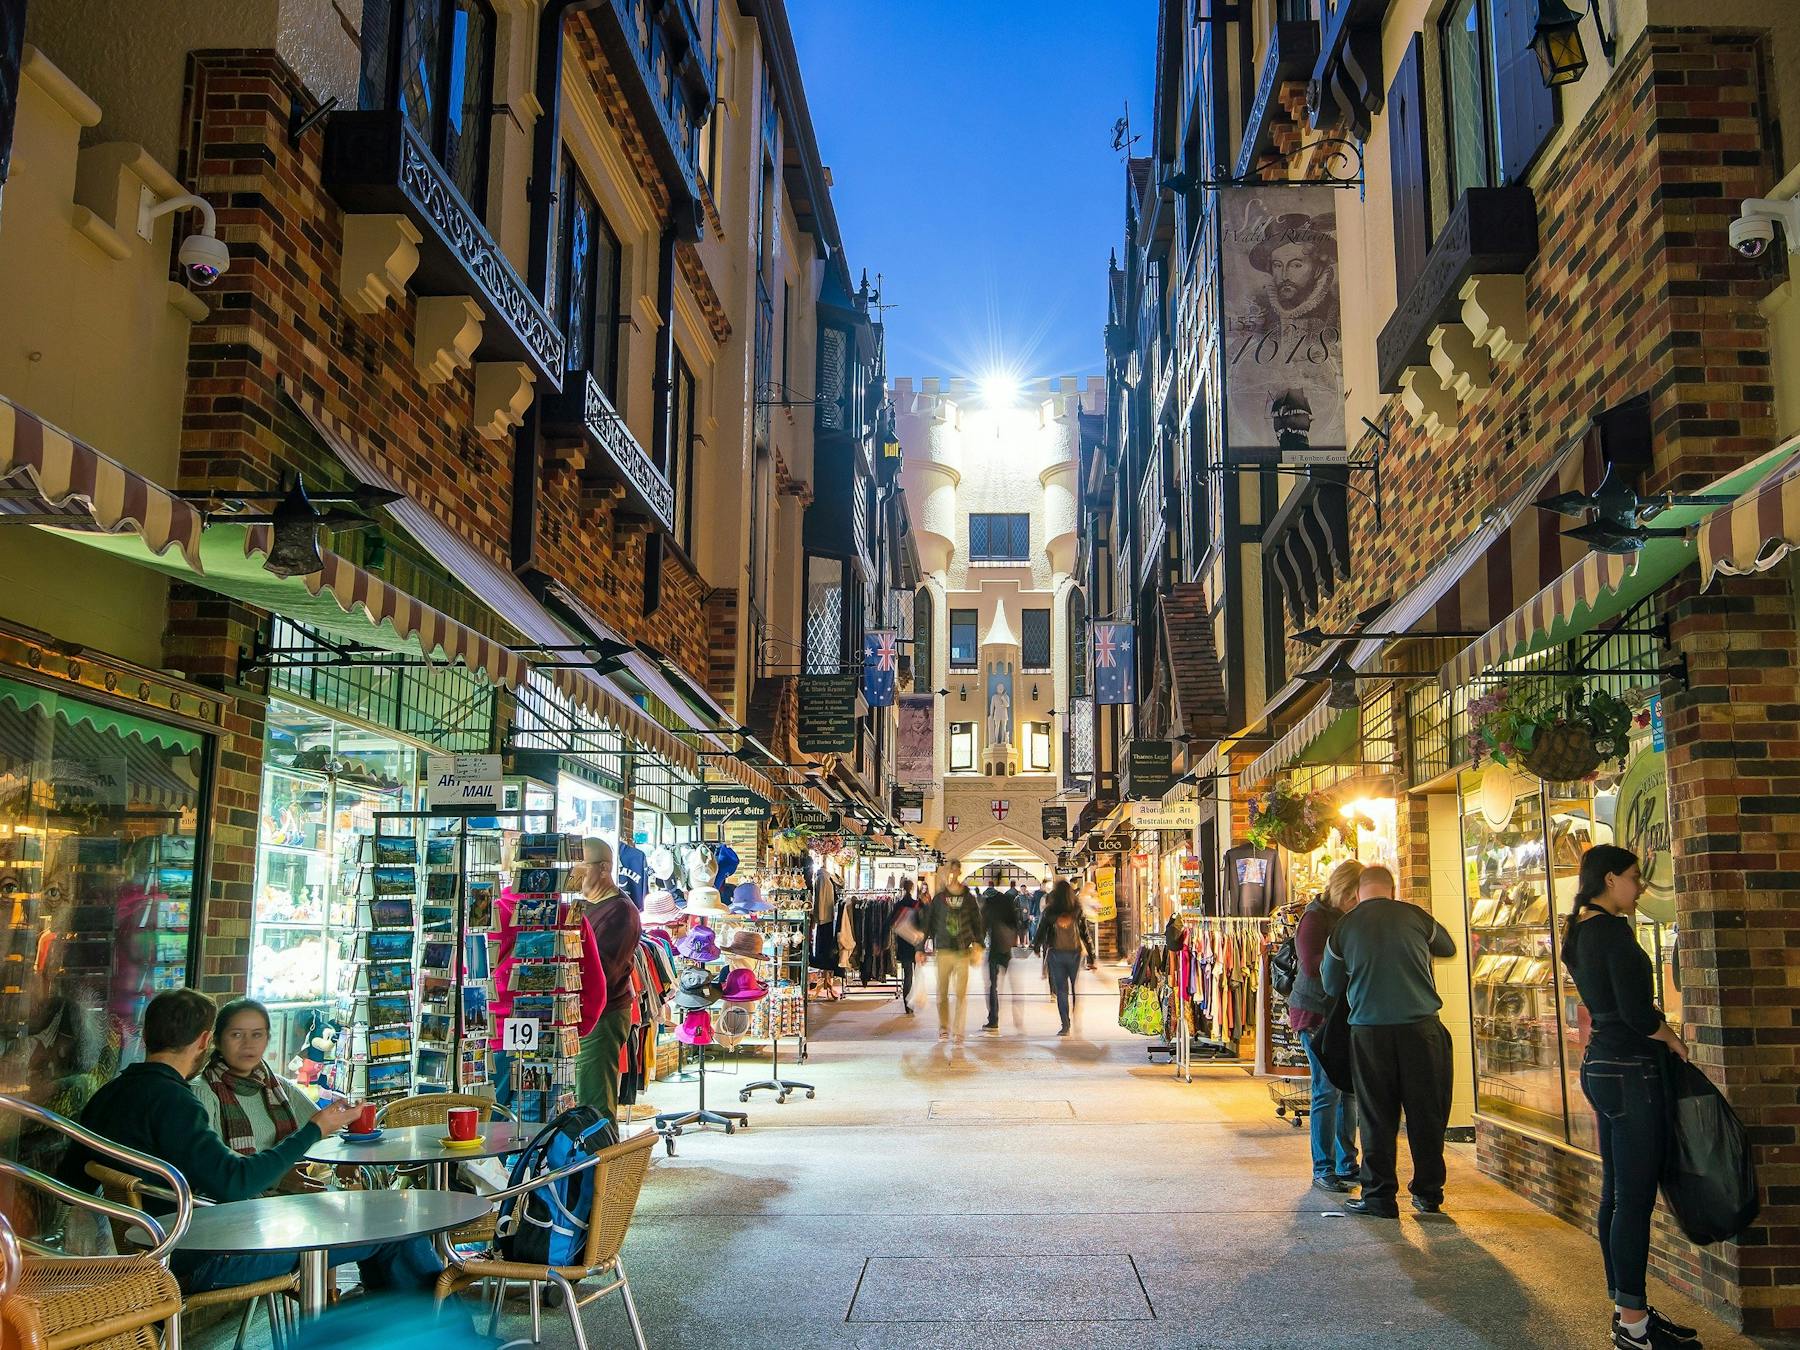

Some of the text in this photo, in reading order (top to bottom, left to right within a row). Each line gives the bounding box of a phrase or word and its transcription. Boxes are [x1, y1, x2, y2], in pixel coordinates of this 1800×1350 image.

[1231, 324, 1340, 365] 1618
[1299, 454, 1346, 463] London Court
[1154, 753, 1169, 761] Legal
[462, 784, 493, 797] MAIL
[710, 795, 750, 805] Billabong
[743, 806, 765, 816] Gifts
[1179, 806, 1191, 814] Art
[1137, 817, 1194, 825] Australian Gifts
[1098, 841, 1122, 850] UGG
[1097, 880, 1113, 889] UGG
[510, 1023, 533, 1045] 19
